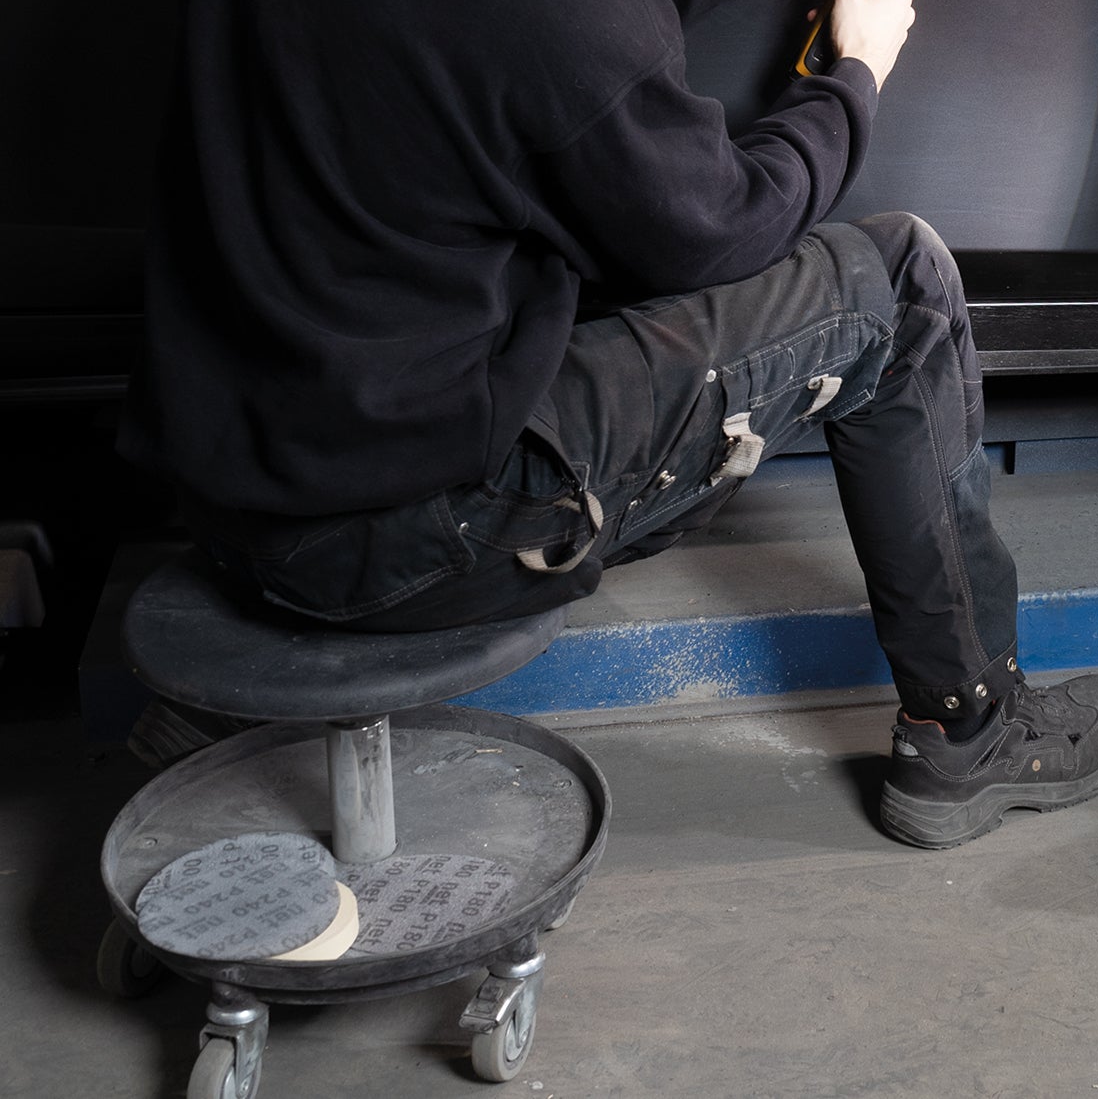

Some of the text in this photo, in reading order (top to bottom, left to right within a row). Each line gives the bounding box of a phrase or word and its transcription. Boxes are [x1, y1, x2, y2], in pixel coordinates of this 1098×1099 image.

[455, 859, 486, 878] 180
[184, 886, 245, 914] P240
[232, 887, 293, 917] P240
[389, 879, 431, 913] P180
[428, 882, 460, 906] net
[462, 881, 501, 916] P180
[361, 918, 394, 947] net
